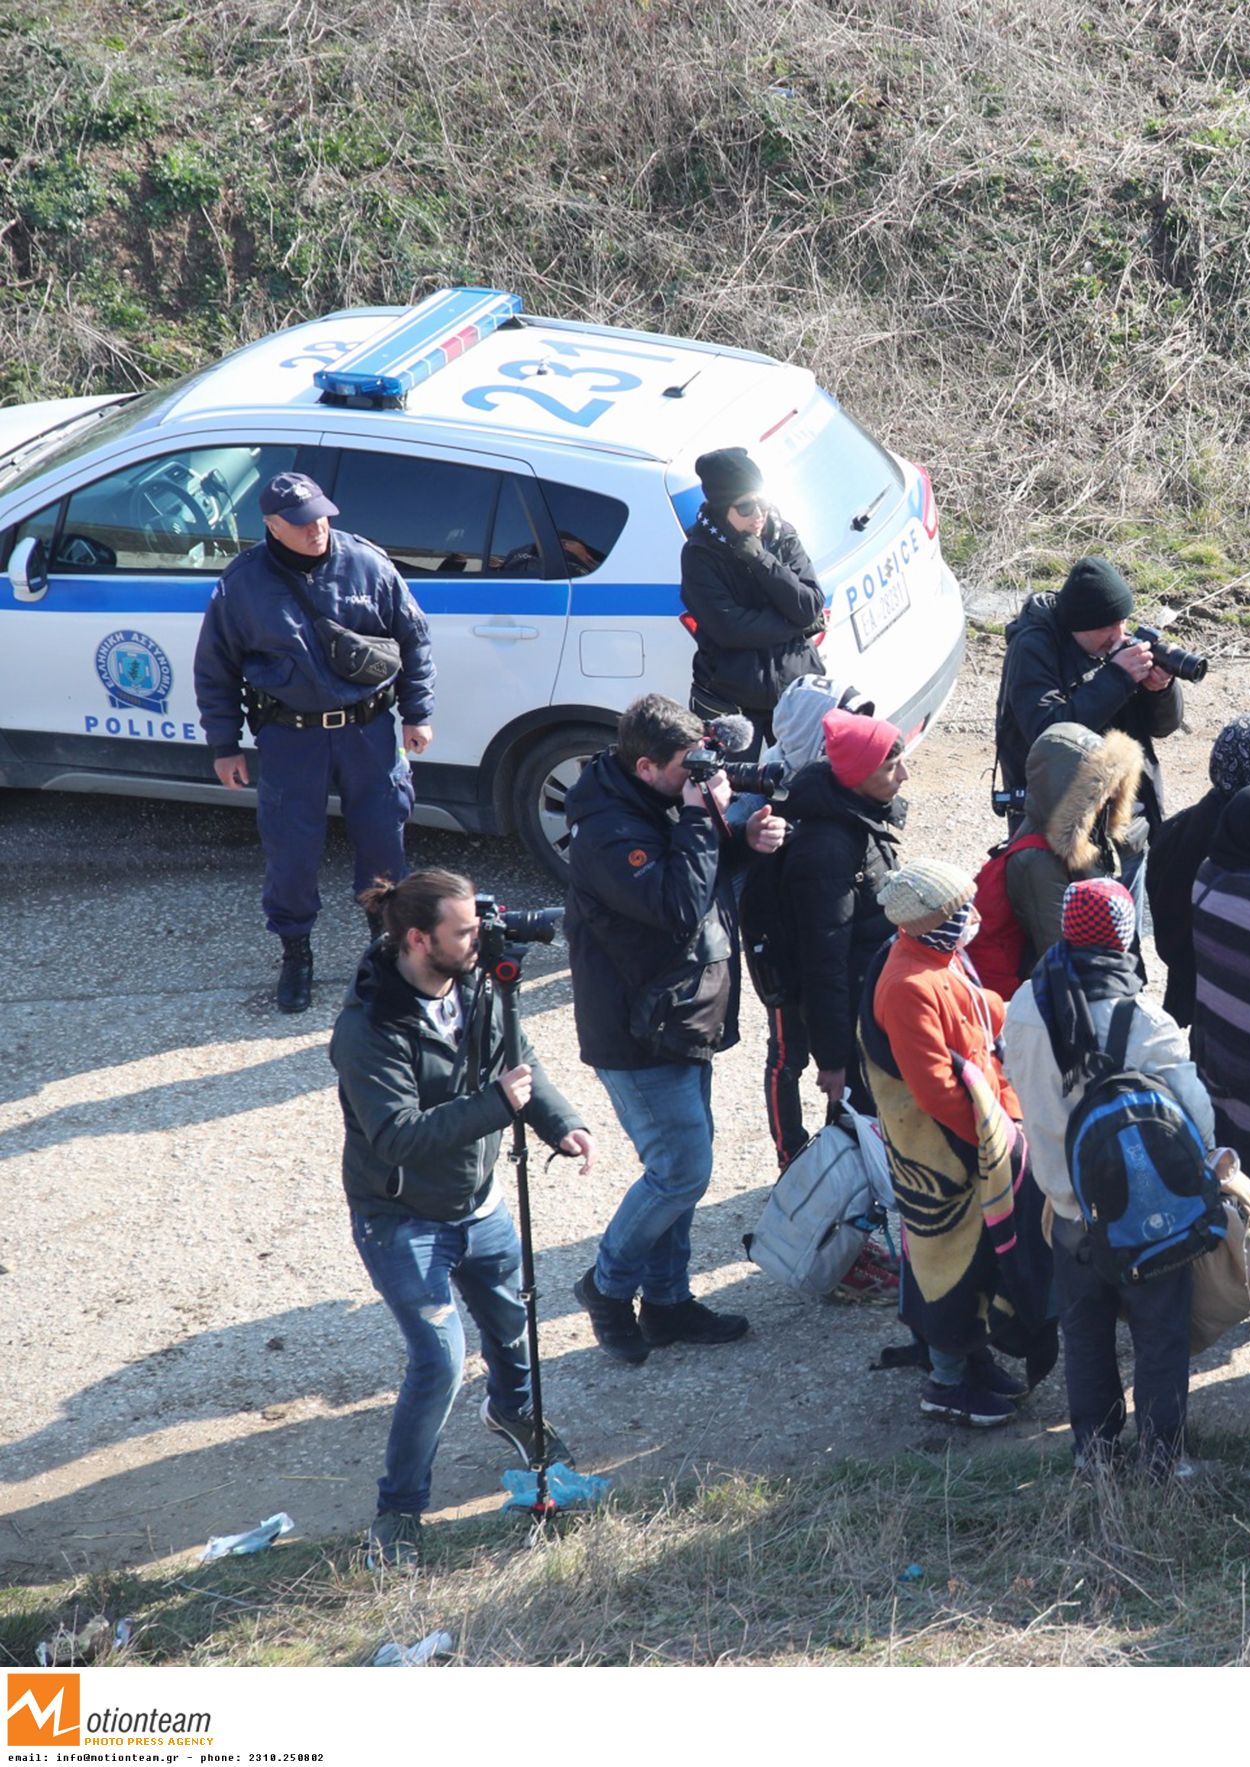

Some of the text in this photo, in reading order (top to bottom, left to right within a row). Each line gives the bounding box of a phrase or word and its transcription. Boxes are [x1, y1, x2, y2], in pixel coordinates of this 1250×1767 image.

[462, 339, 676, 428] 231
[846, 529, 919, 612] POLICE
[97, 631, 171, 696] ΕΛΛΗΝΙΚΗ ΑΣΤΥΝΟΜΙΑ
[84, 715, 197, 740] POLICE
